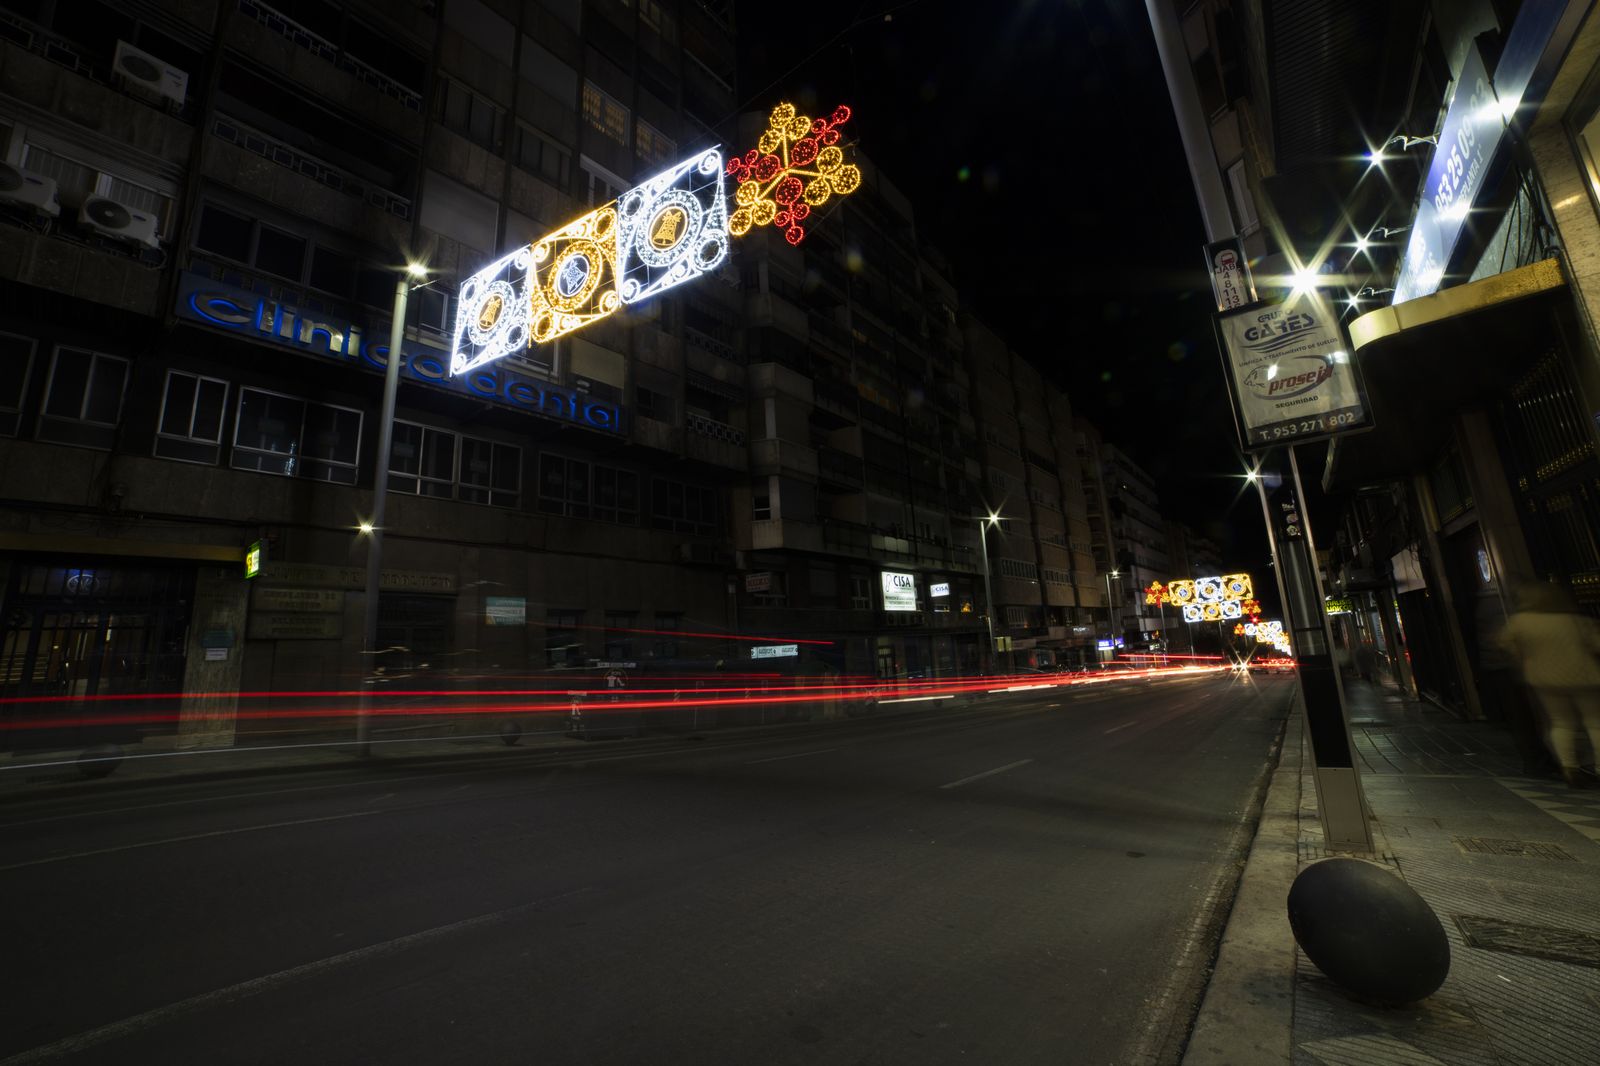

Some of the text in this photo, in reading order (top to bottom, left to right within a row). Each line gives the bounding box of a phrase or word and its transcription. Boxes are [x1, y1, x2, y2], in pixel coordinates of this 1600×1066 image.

[1447, 143, 1463, 191] 25
[1224, 280, 1232, 289] 8
[1223, 287, 1237, 297] 11
[1225, 295, 1240, 305] 13
[1307, 342, 1316, 350] DE
[465, 367, 621, 433] dental
[1275, 395, 1319, 408] SEGURIDAD
[1273, 424, 1298, 438] 953
[1301, 419, 1324, 432] 271
[1329, 412, 1355, 426] 802
[893, 575, 911, 588] CISA
[935, 585, 949, 593] CISA
